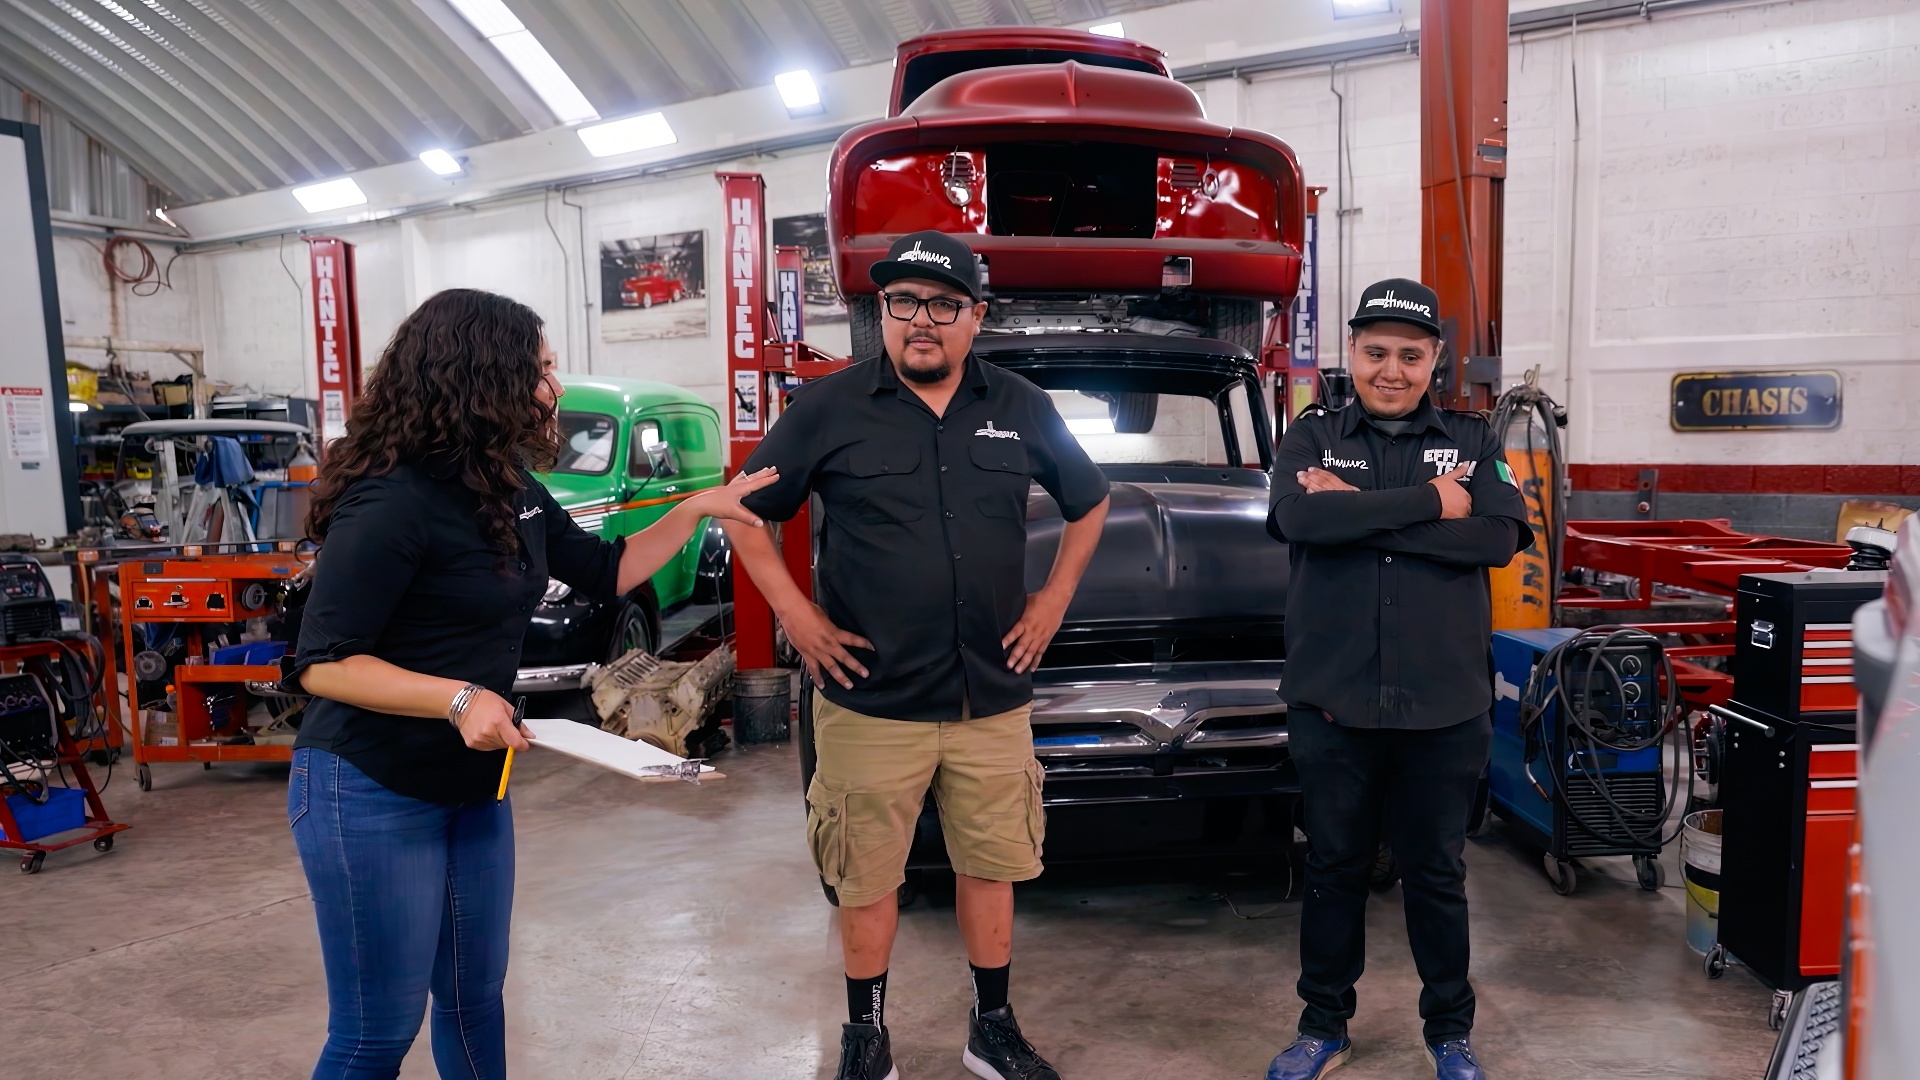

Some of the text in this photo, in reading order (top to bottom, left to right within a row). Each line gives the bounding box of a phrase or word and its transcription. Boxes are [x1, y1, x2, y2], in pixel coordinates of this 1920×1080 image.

[731, 198, 755, 359] HANTEC
[315, 256, 341, 383] HANTEC
[1702, 387, 1808, 416] CHASIS
[1423, 448, 1459, 463] EFFI
[1435, 460, 1477, 476] TE
